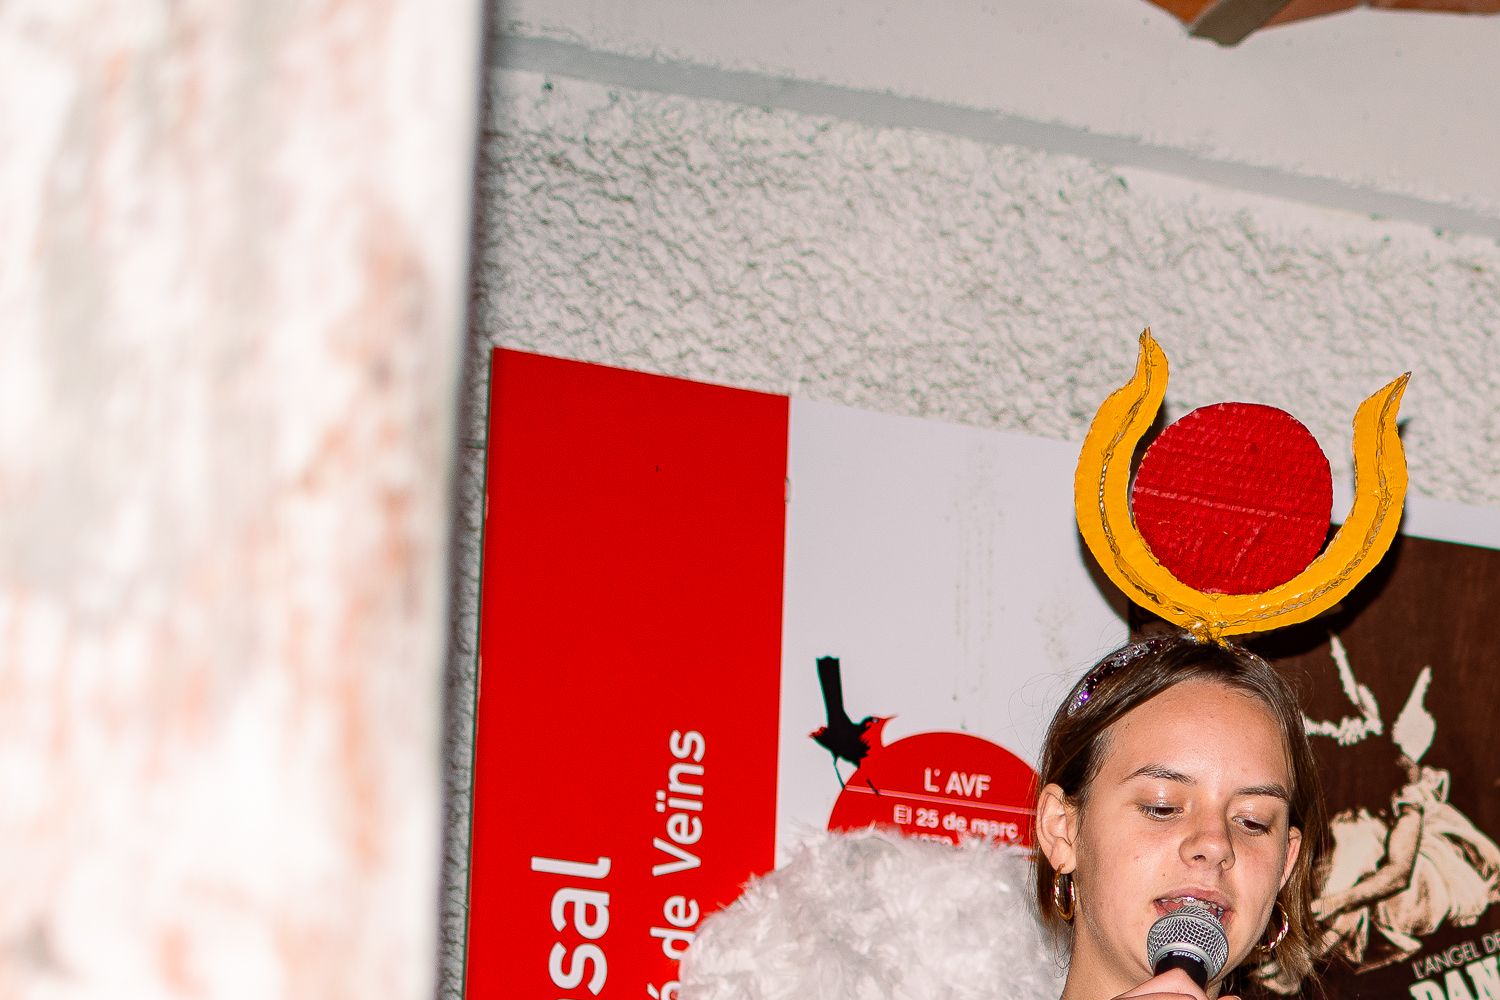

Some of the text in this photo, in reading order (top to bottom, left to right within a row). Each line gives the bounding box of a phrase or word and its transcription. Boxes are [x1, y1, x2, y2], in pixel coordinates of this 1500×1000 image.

[651, 729, 706, 878] Veïns
[893, 804, 913, 825] El
[915, 808, 940, 829] 25
[942, 811, 967, 833] de
[650, 895, 701, 962] de
